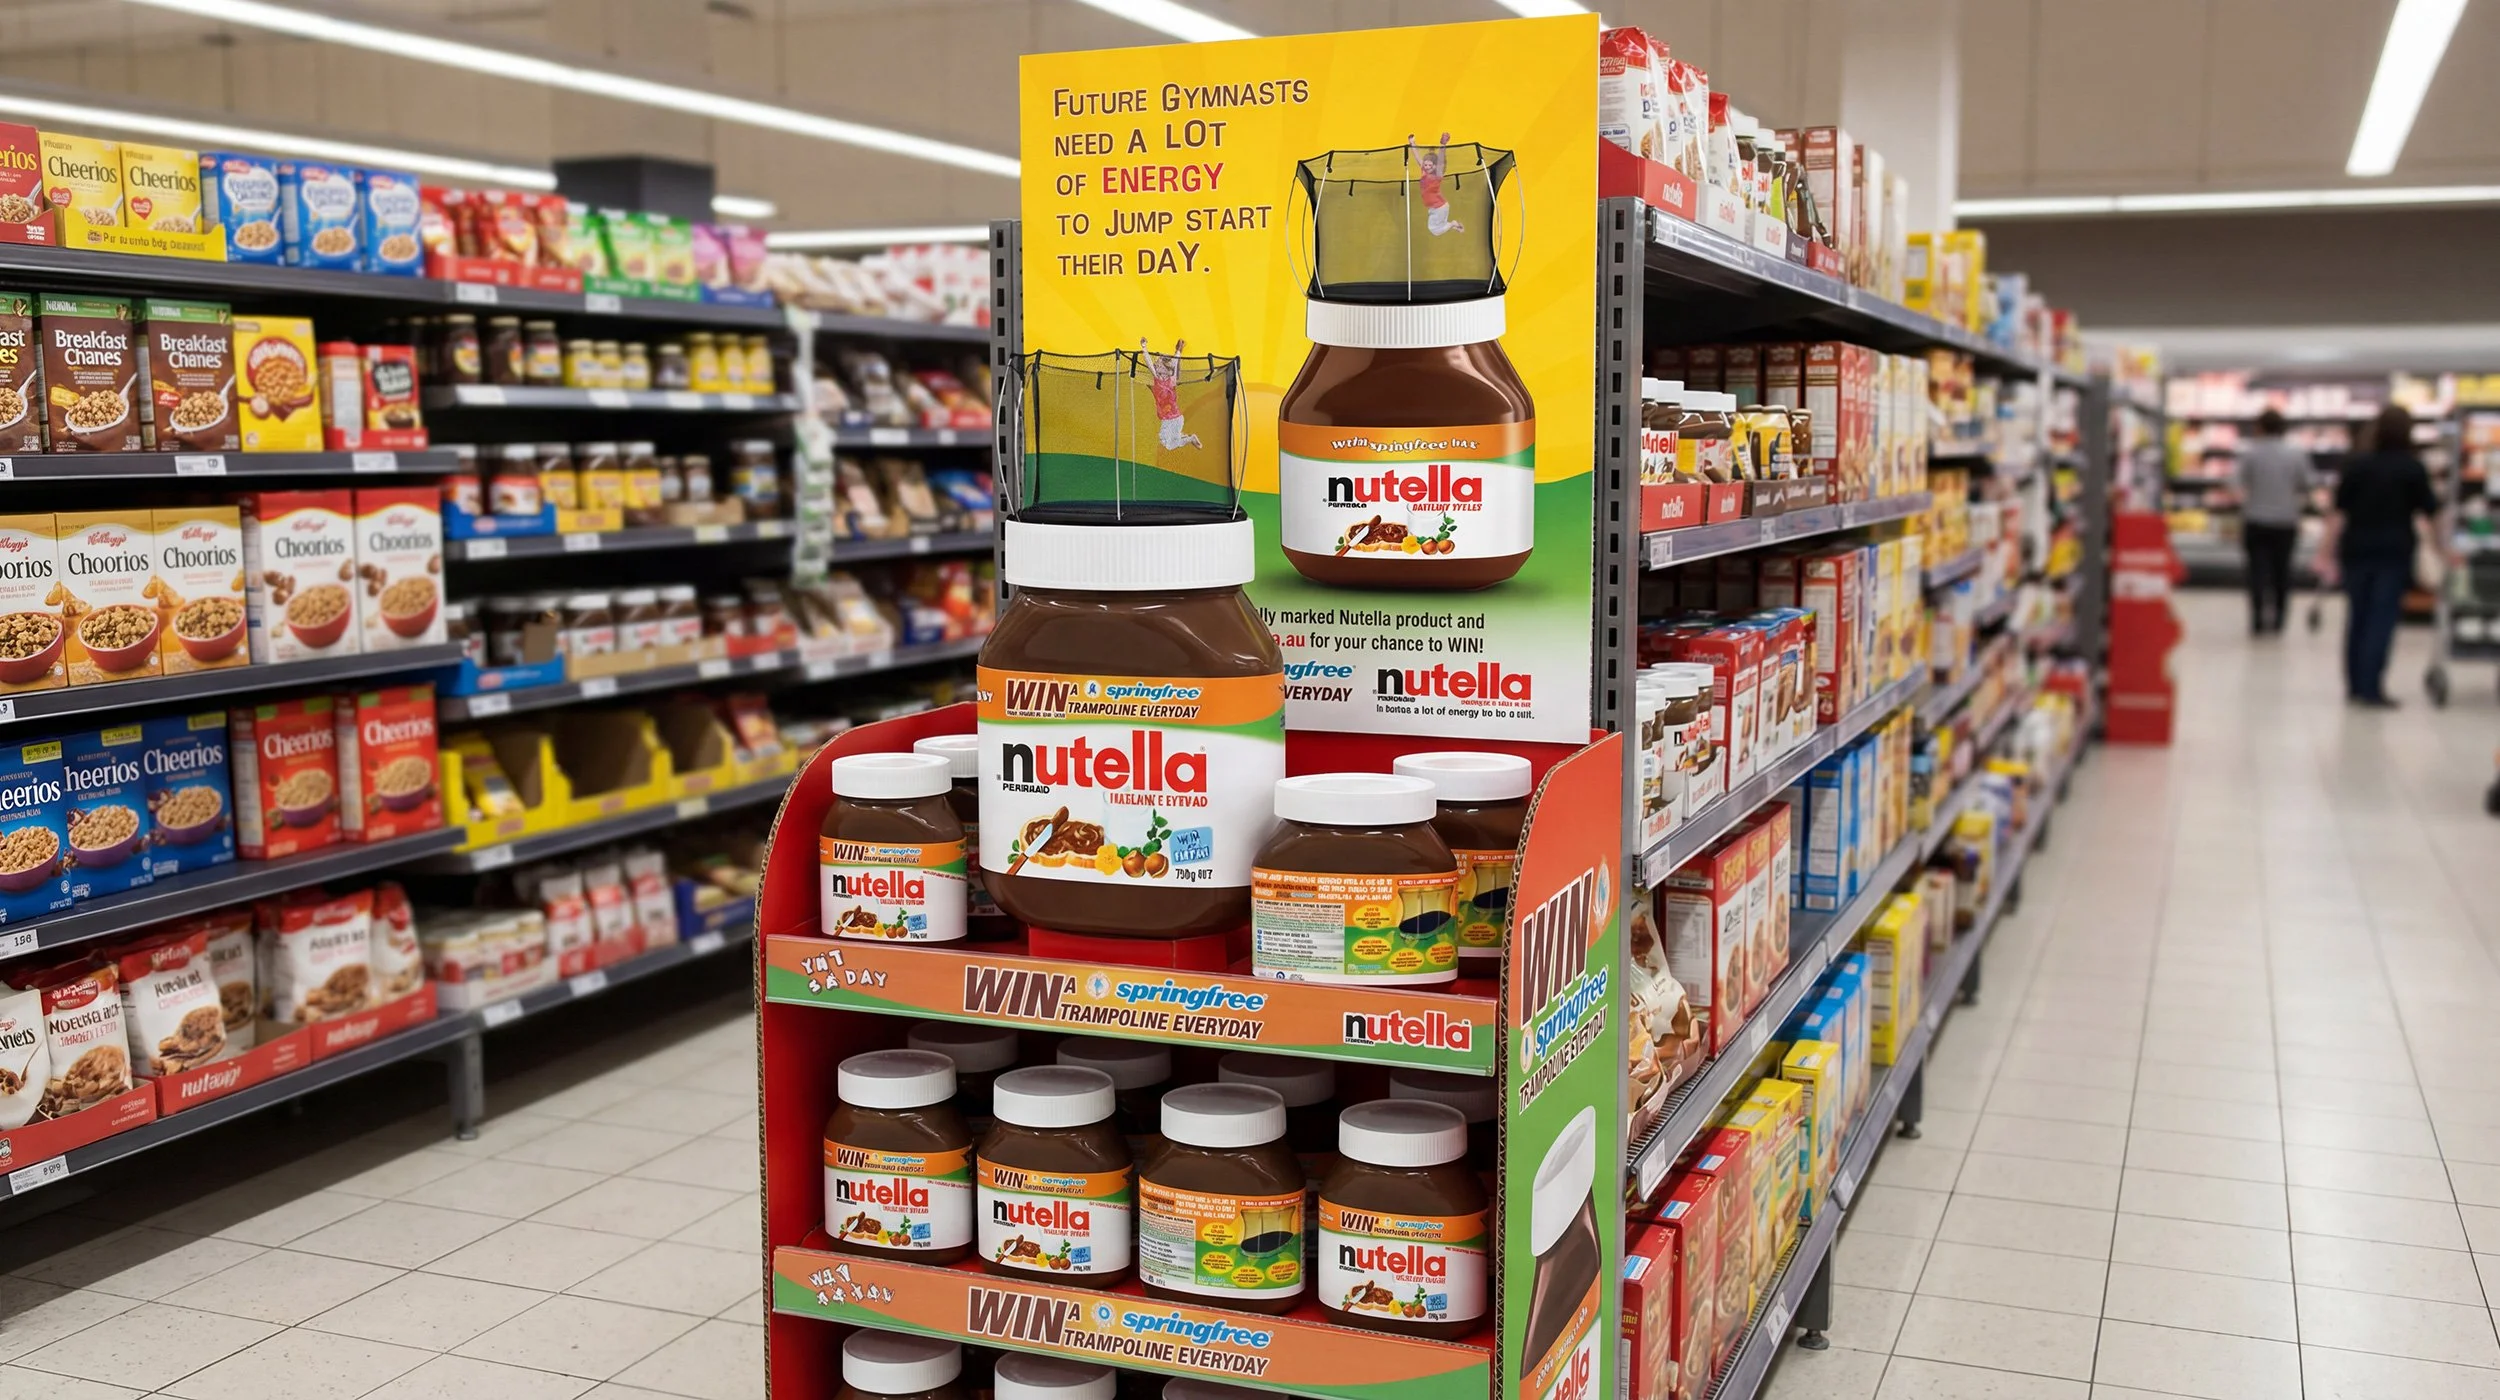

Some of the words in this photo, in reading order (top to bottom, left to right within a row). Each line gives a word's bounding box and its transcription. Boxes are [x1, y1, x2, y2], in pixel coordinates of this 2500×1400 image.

[1054, 133, 1113, 156] NEED
[1127, 128, 1147, 154] A
[1165, 119, 1227, 149] LOT
[48, 155, 118, 184] Cheerios
[129, 165, 197, 193] Cheerios
[1056, 174, 1087, 196] OF
[1102, 162, 1224, 194] ENERGY
[1056, 213, 1090, 236] TO
[1105, 209, 1173, 237] JUMP
[1186, 206, 1272, 232] START
[1057, 253, 1123, 276] THEIR
[1138, 240, 1211, 275] DAY.
[54, 329, 128, 350] Breakfast
[160, 333, 228, 353] Breakfast
[64, 348, 122, 366] Chanes
[168, 351, 222, 369] Chanes
[1328, 465, 1482, 503] nutella
[163, 545, 237, 570] Choorios
[274, 535, 345, 559] Choorios
[68, 551, 150, 577] Choorios
[1281, 608, 1334, 626] marked
[1340, 609, 1391, 627] Nutella
[1396, 612, 1453, 630] product
[1457, 613, 1485, 630] and
[1310, 632, 1330, 648] for
[1334, 635, 1366, 652] your
[1371, 635, 1424, 652] chance
[1429, 637, 1443, 652] to
[1448, 637, 1485, 653] WIN!
[1006, 679, 1070, 712] WIN
[1070, 683, 1078, 696] A
[1106, 682, 1200, 701] springfree
[1377, 661, 1532, 701] nutella
[1068, 702, 1138, 717] TRAMPOLINE
[1140, 703, 1199, 718] EVERYDAY
[364, 714, 434, 747] Cheerios
[143, 742, 223, 776] Cheerios
[1003, 730, 1207, 793] nutella
[834, 842, 865, 861] WIN
[832, 870, 925, 899] nutella
[1522, 867, 1594, 1031] WIN
[844, 967, 888, 988] DAY
[965, 966, 1064, 1019] WIN
[1064, 976, 1076, 994] A
[1116, 981, 1264, 1011] springfree
[1061, 1003, 1169, 1031] TRAMPOLINE
[1173, 1014, 1264, 1040] EVERYDAY
[1536, 966, 1608, 1062] springfree
[1345, 1011, 1471, 1051] nutella
[837, 1148, 865, 1169] WIN
[836, 1178, 929, 1208] nutella
[993, 1168, 1024, 1189] WIN
[993, 1200, 1090, 1230] nutella
[1341, 1211, 1375, 1233] WIN
[1339, 1244, 1446, 1277] nutella
[968, 1287, 1068, 1345] WIN
[1068, 1307, 1081, 1322] A
[1122, 1309, 1271, 1348] springfree
[1064, 1329, 1173, 1362] TRAMPOLINE
[1177, 1348, 1269, 1377] EVERYDAY
